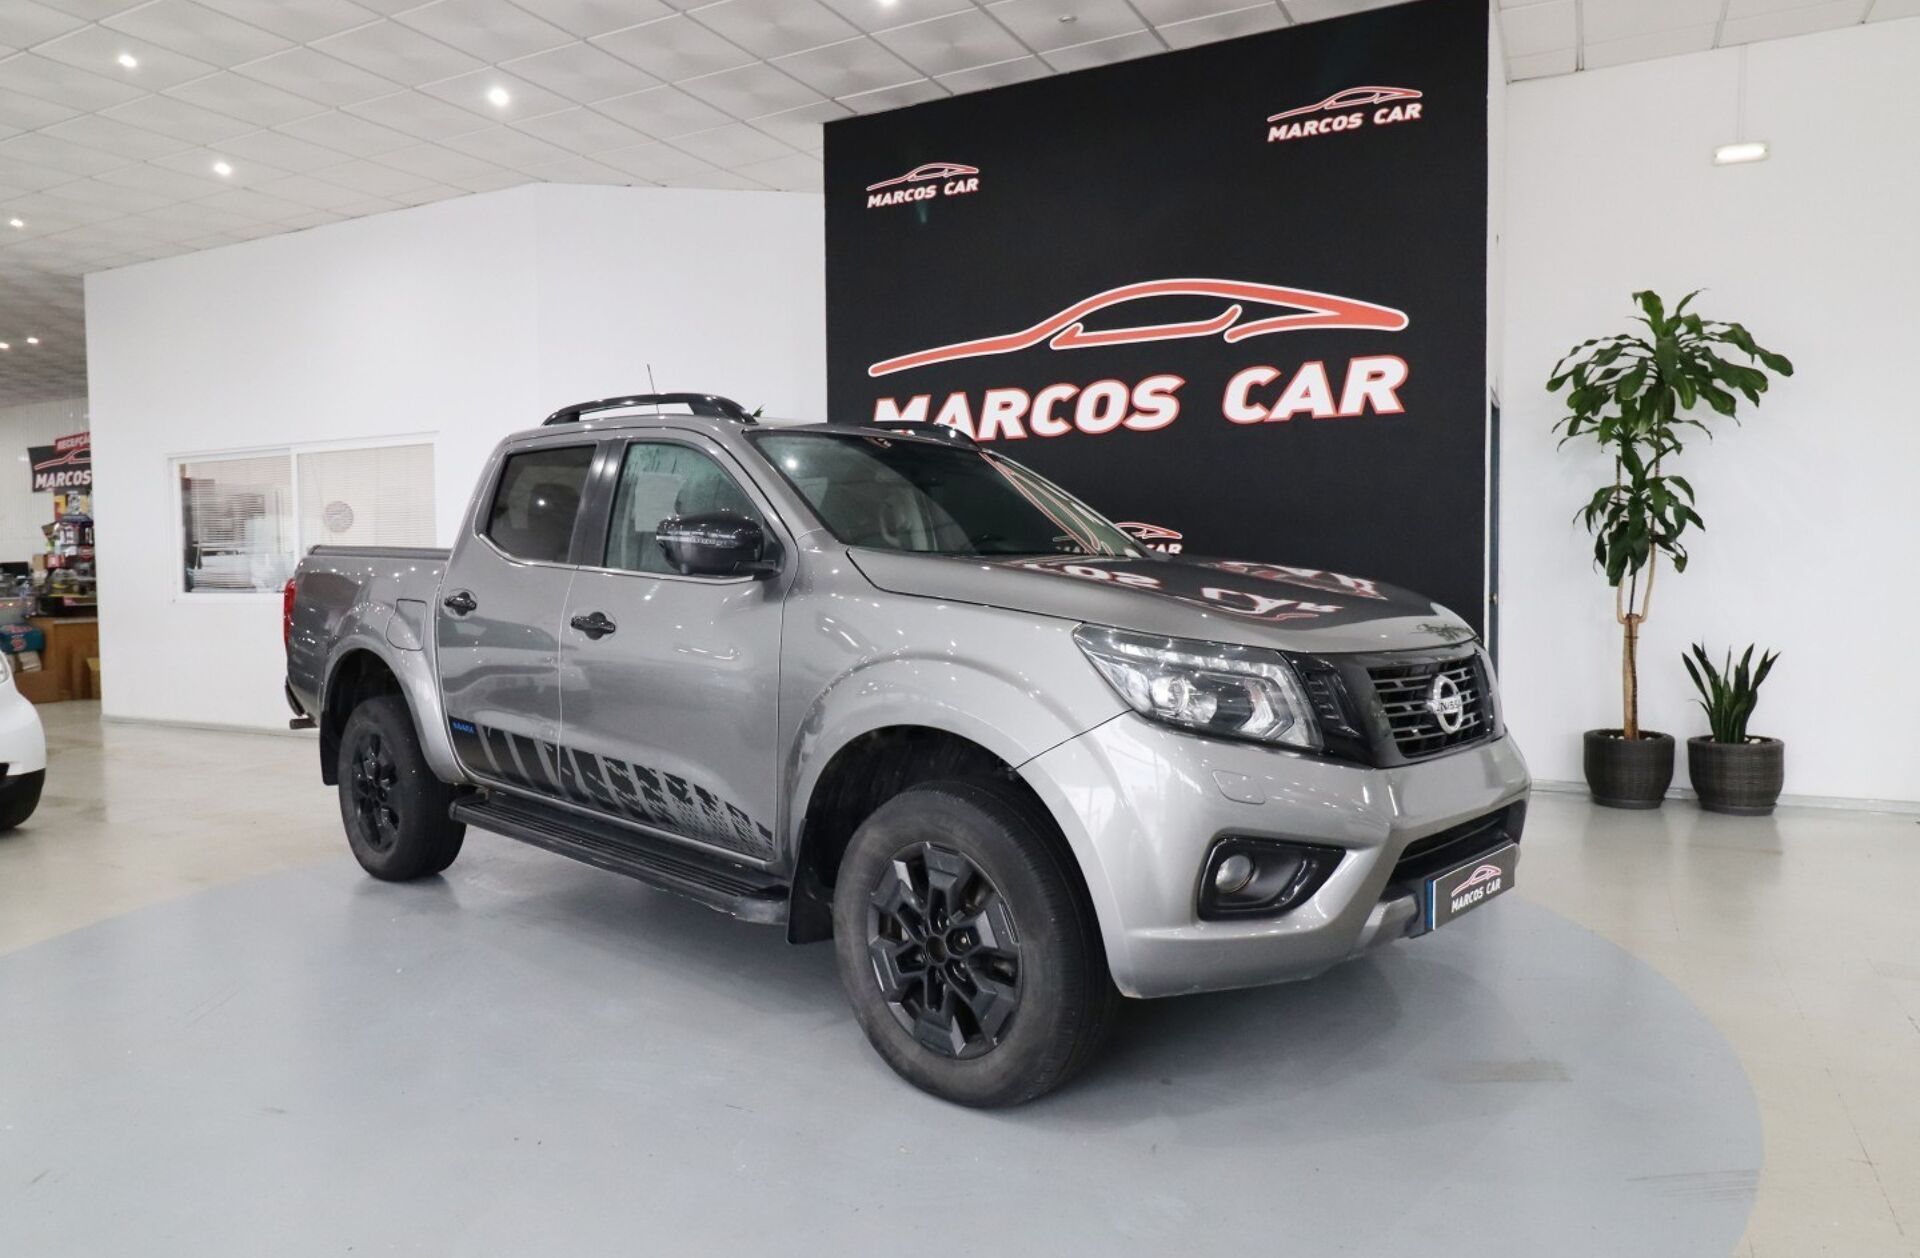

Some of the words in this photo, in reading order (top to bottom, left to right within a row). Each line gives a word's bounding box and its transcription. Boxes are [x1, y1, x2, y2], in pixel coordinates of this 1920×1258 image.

[1266, 111, 1365, 143] MARCOS
[1372, 102, 1424, 125] CAR
[866, 184, 938, 209] MARCOS
[943, 177, 980, 196] CAR
[1222, 355, 1409, 424] CAR
[35, 470, 92, 489] MARCOS
[1451, 886, 1484, 914] MARCOS
[1485, 877, 1502, 895] CAR
